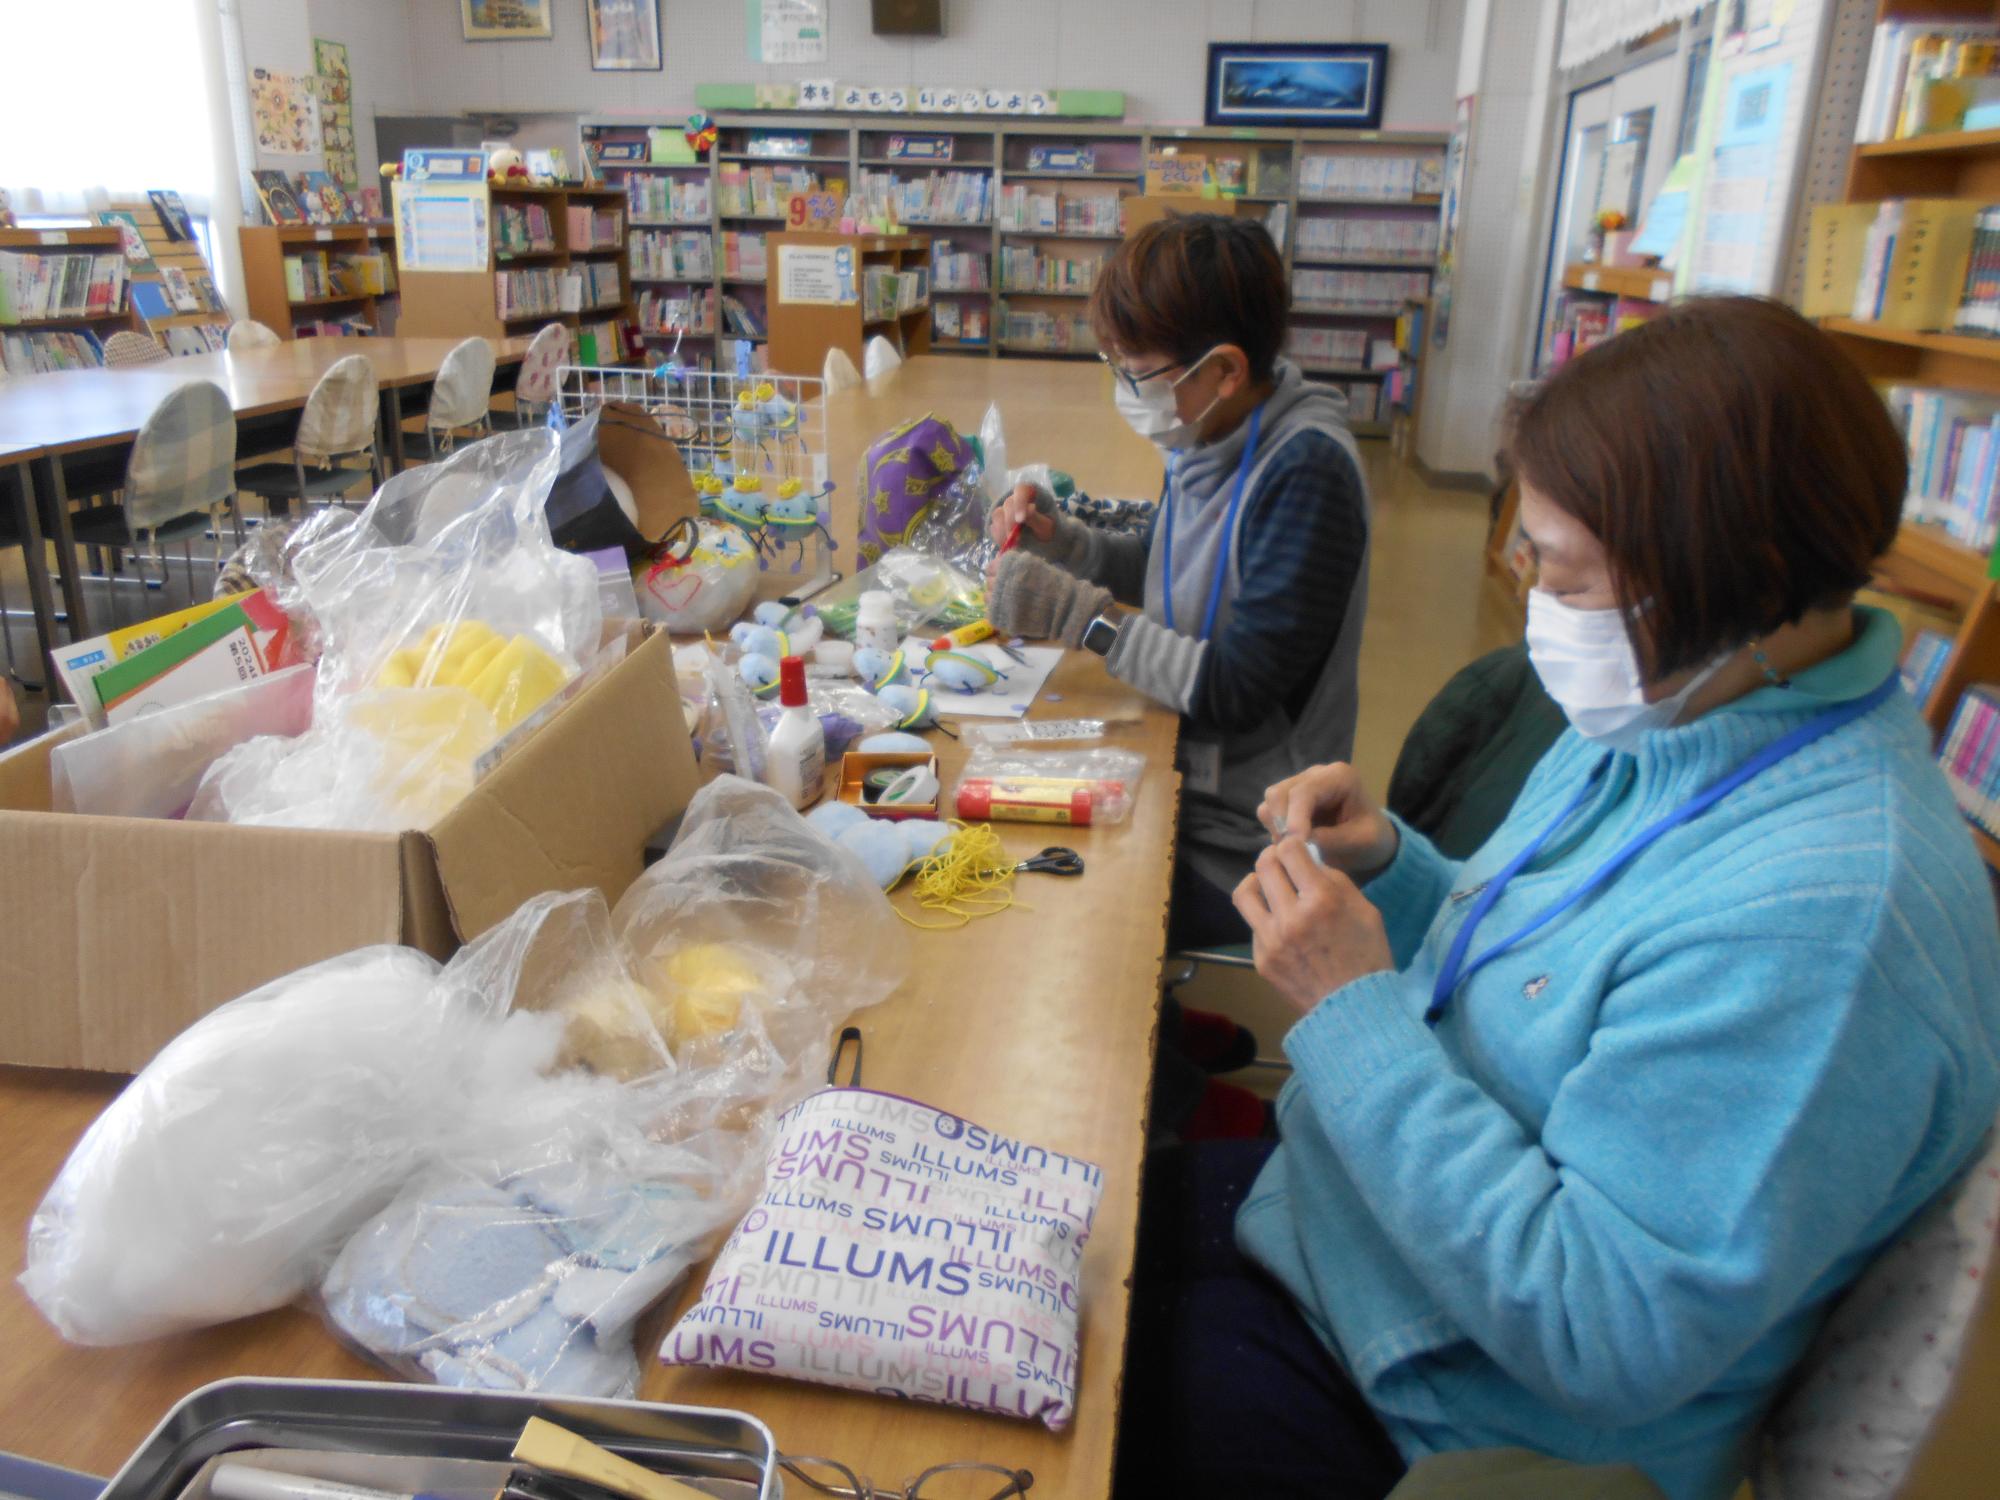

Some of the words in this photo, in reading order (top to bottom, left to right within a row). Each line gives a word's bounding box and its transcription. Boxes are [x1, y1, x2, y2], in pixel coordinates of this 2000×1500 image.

[802, 83, 830, 102] 本を
[846, 91, 905, 106] よもう
[789, 196, 806, 226] 9
[832, 1118, 897, 1144] ILLUMS
[880, 1150, 949, 1182] ILLUMS
[911, 1142, 1019, 1186] ILLUMS
[965, 1126, 1100, 1187] ILLUMS
[773, 1153, 931, 1204] ILLUMS
[765, 1192, 853, 1218] ILLUMS
[985, 1205, 1070, 1240] ILLUMS
[862, 1207, 1013, 1253] ILLUMS
[763, 1229, 972, 1297] ILLUMS
[948, 1245, 1058, 1290] ILLUMS
[755, 1293, 818, 1314] ILLUMS
[978, 1271, 1063, 1313] ILLUMS
[818, 1311, 905, 1342] ILLUMS
[905, 1304, 1074, 1384] ILLUMS
[660, 1330, 776, 1369] UMS
[801, 1345, 945, 1391] ILLUMS
[925, 1340, 990, 1364] ILLUMS
